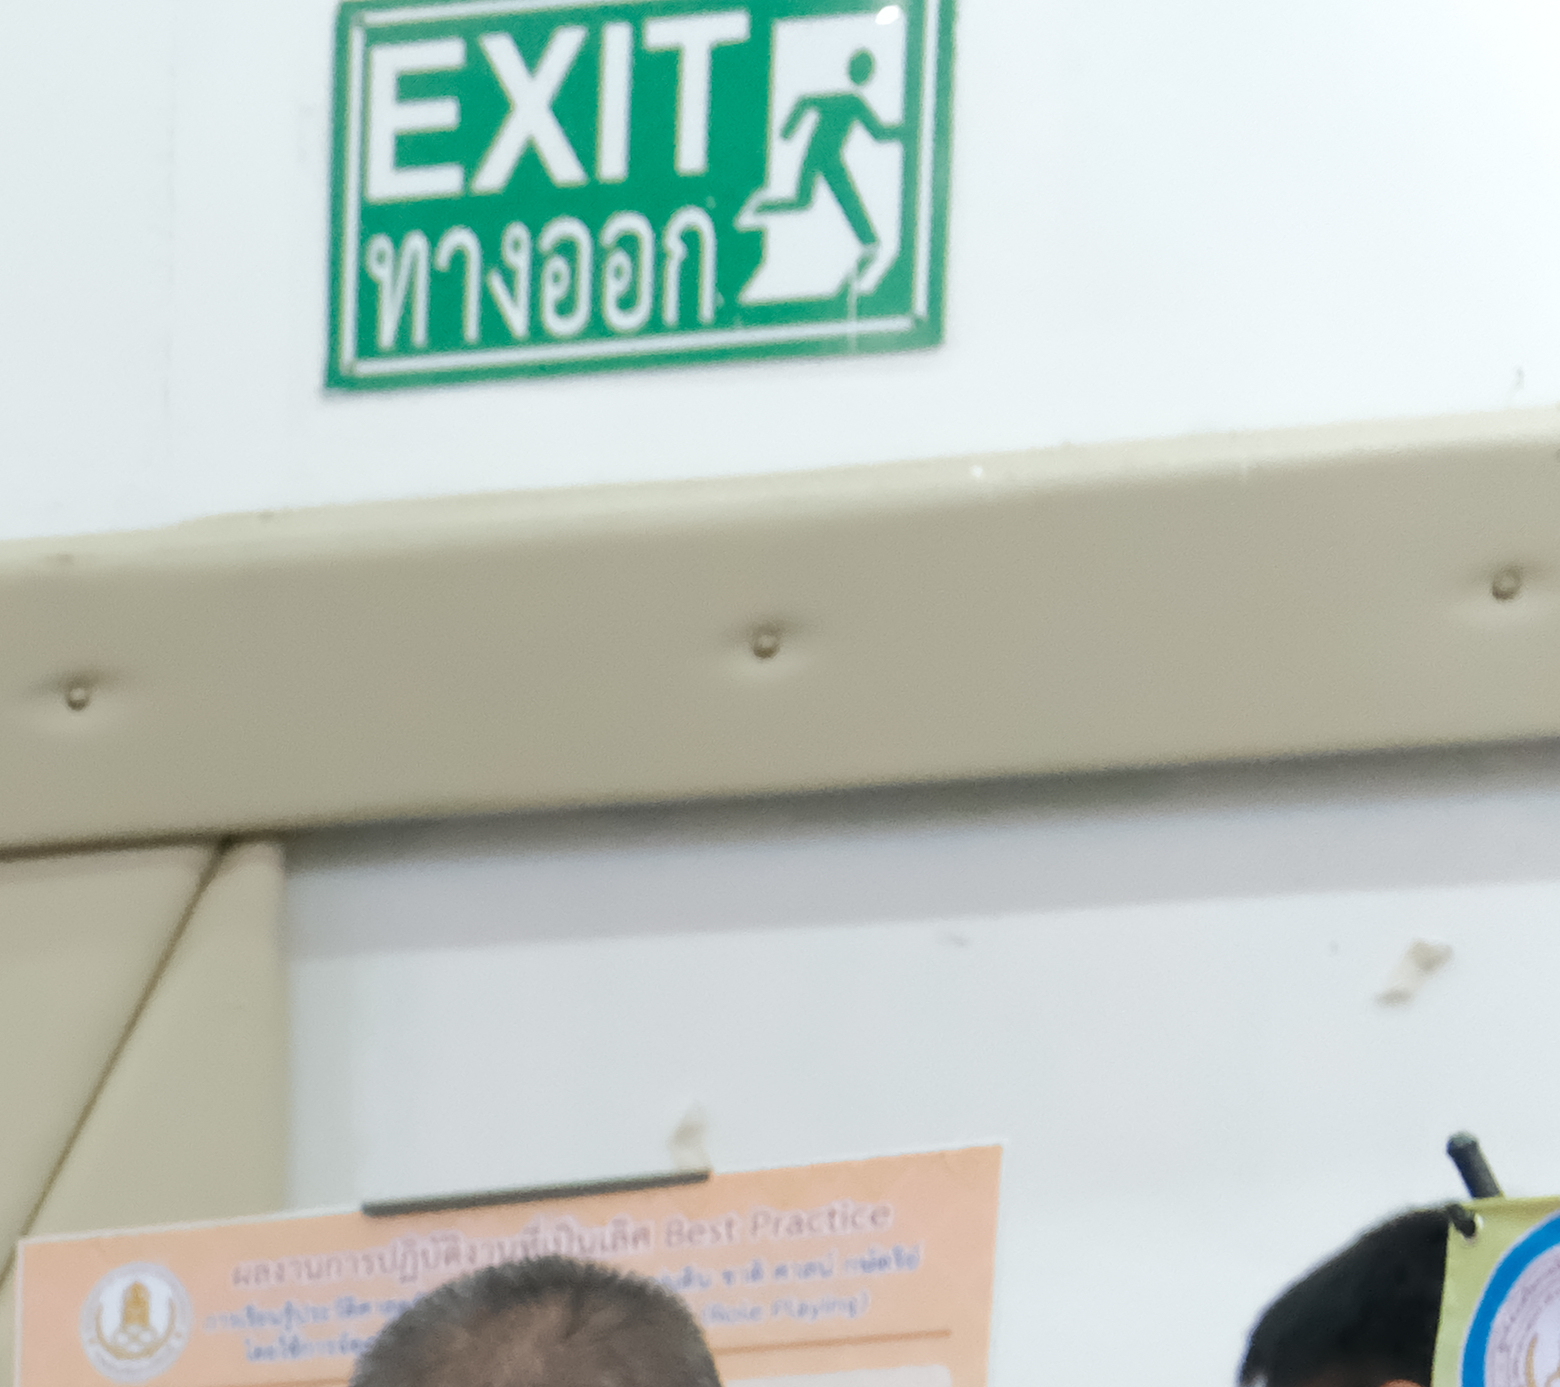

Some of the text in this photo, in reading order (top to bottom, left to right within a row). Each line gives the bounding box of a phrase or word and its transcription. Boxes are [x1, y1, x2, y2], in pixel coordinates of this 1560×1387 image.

[364, 11, 752, 204] EXIT
[366, 205, 717, 350] ทางออก
[665, 1211, 738, 1246] Best
[750, 1199, 895, 1242] Practice
